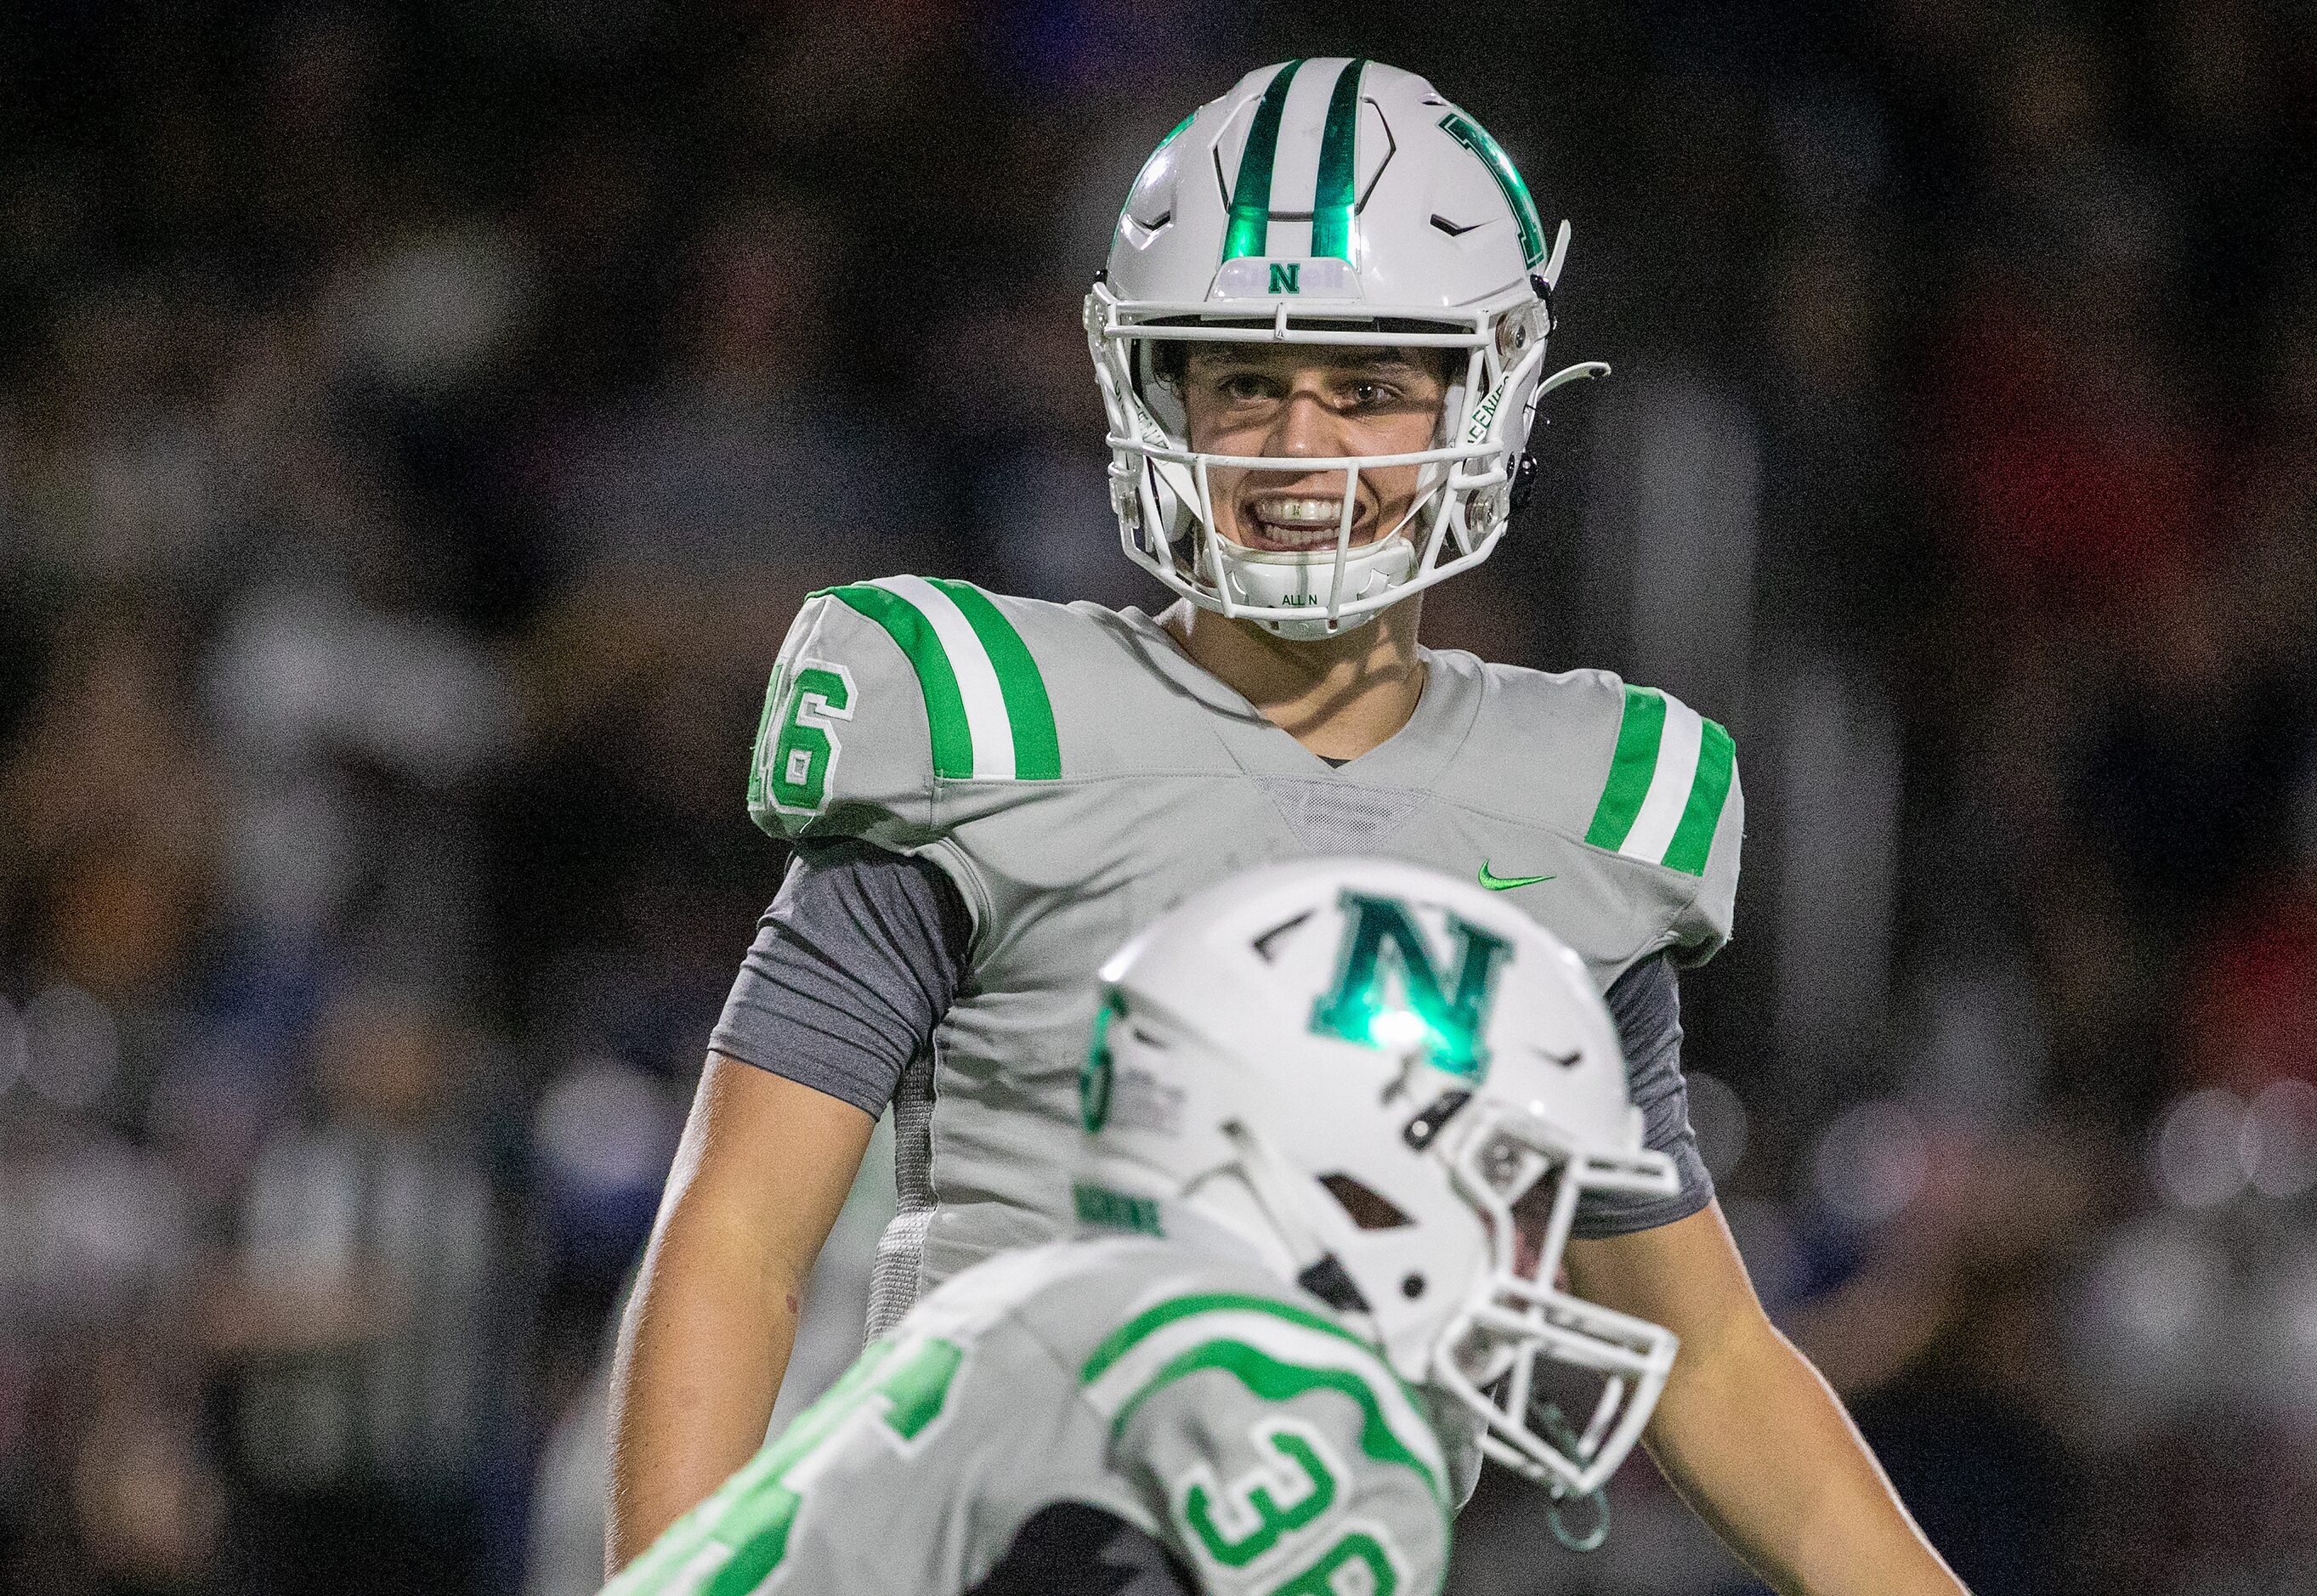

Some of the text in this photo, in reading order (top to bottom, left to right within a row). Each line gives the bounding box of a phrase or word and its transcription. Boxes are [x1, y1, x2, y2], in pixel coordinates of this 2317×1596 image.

[1268, 263, 1300, 294] N
[1282, 594, 1317, 606] ALL N
[1306, 886, 1517, 1088] N
